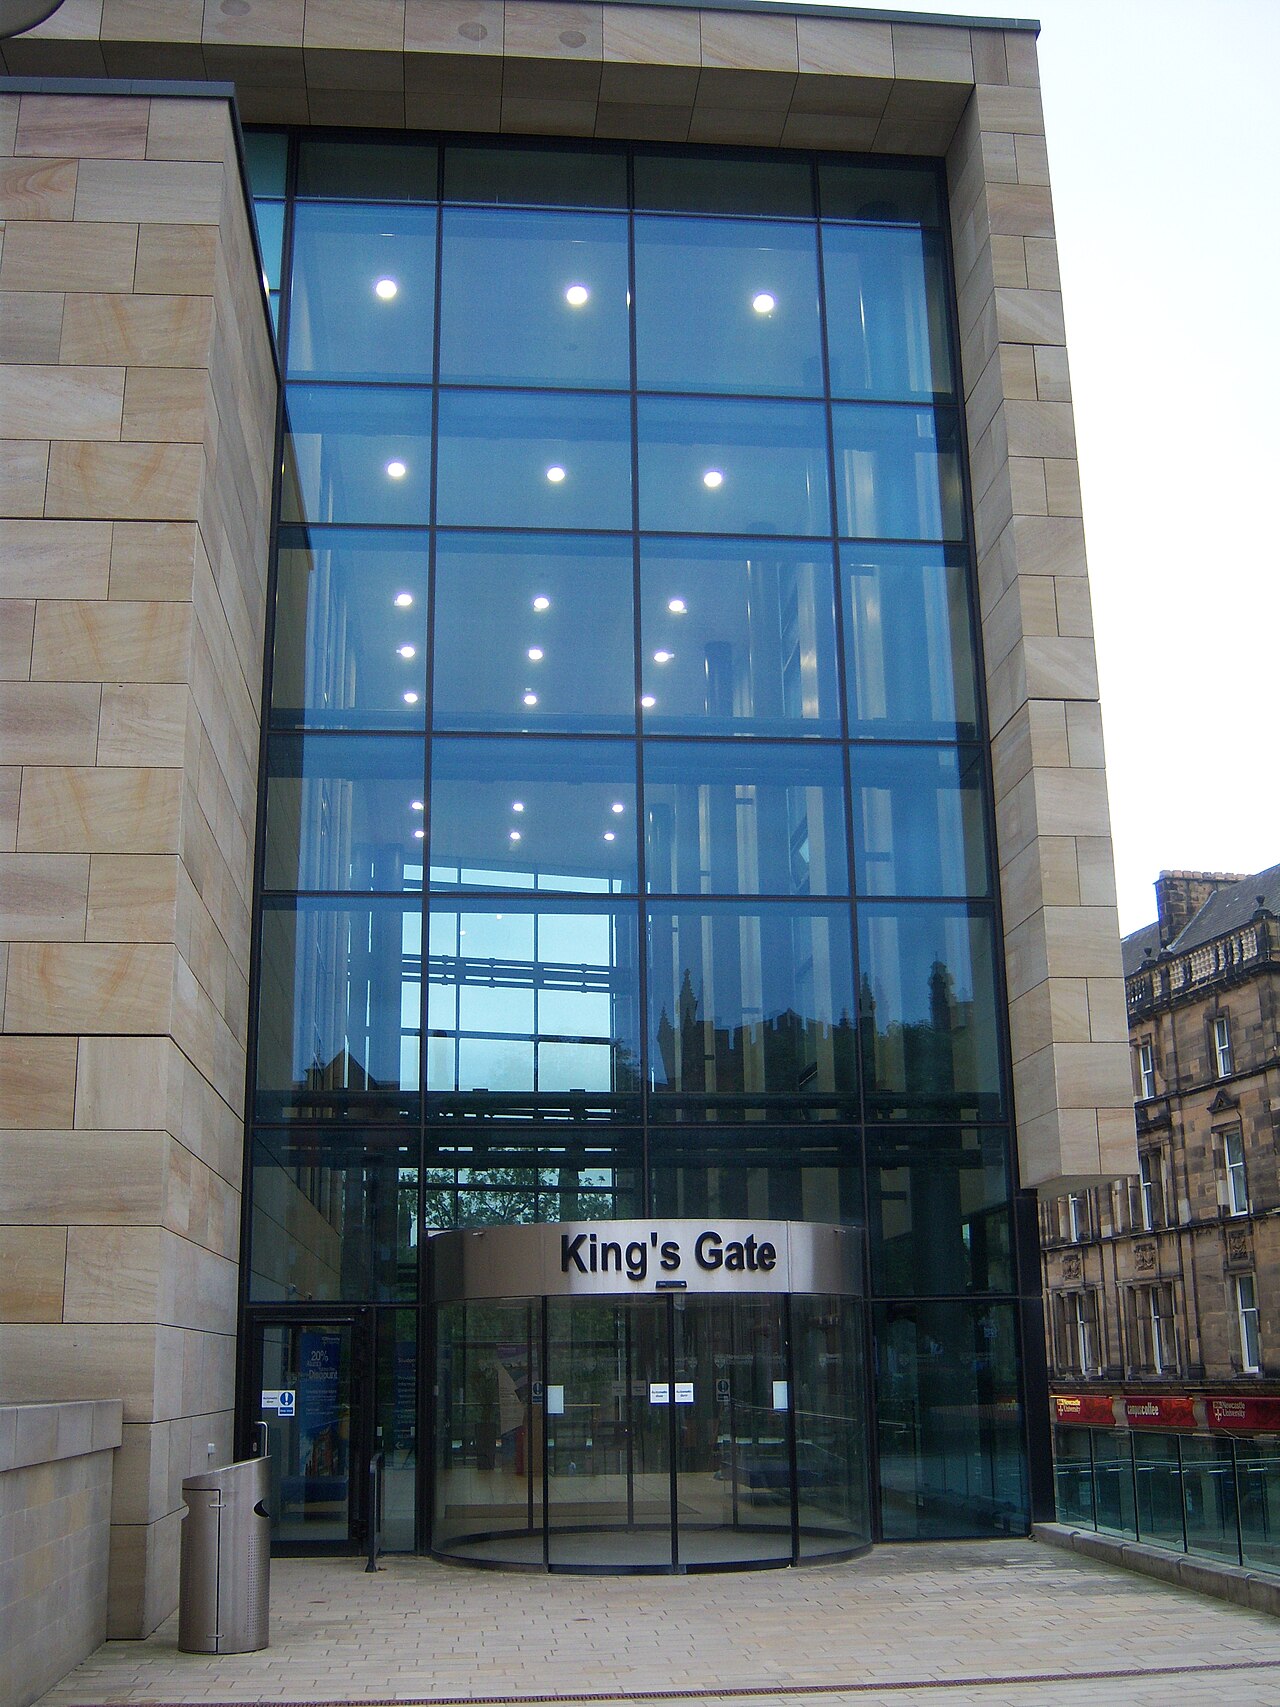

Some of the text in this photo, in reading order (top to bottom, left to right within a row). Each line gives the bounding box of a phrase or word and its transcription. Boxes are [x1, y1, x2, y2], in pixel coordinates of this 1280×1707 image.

[561, 1231, 777, 1281] King's Gate
[311, 1350, 329, 1361] 20%
[1221, 1401, 1246, 1409] Newcastle
[1222, 1408, 1246, 1419] University
